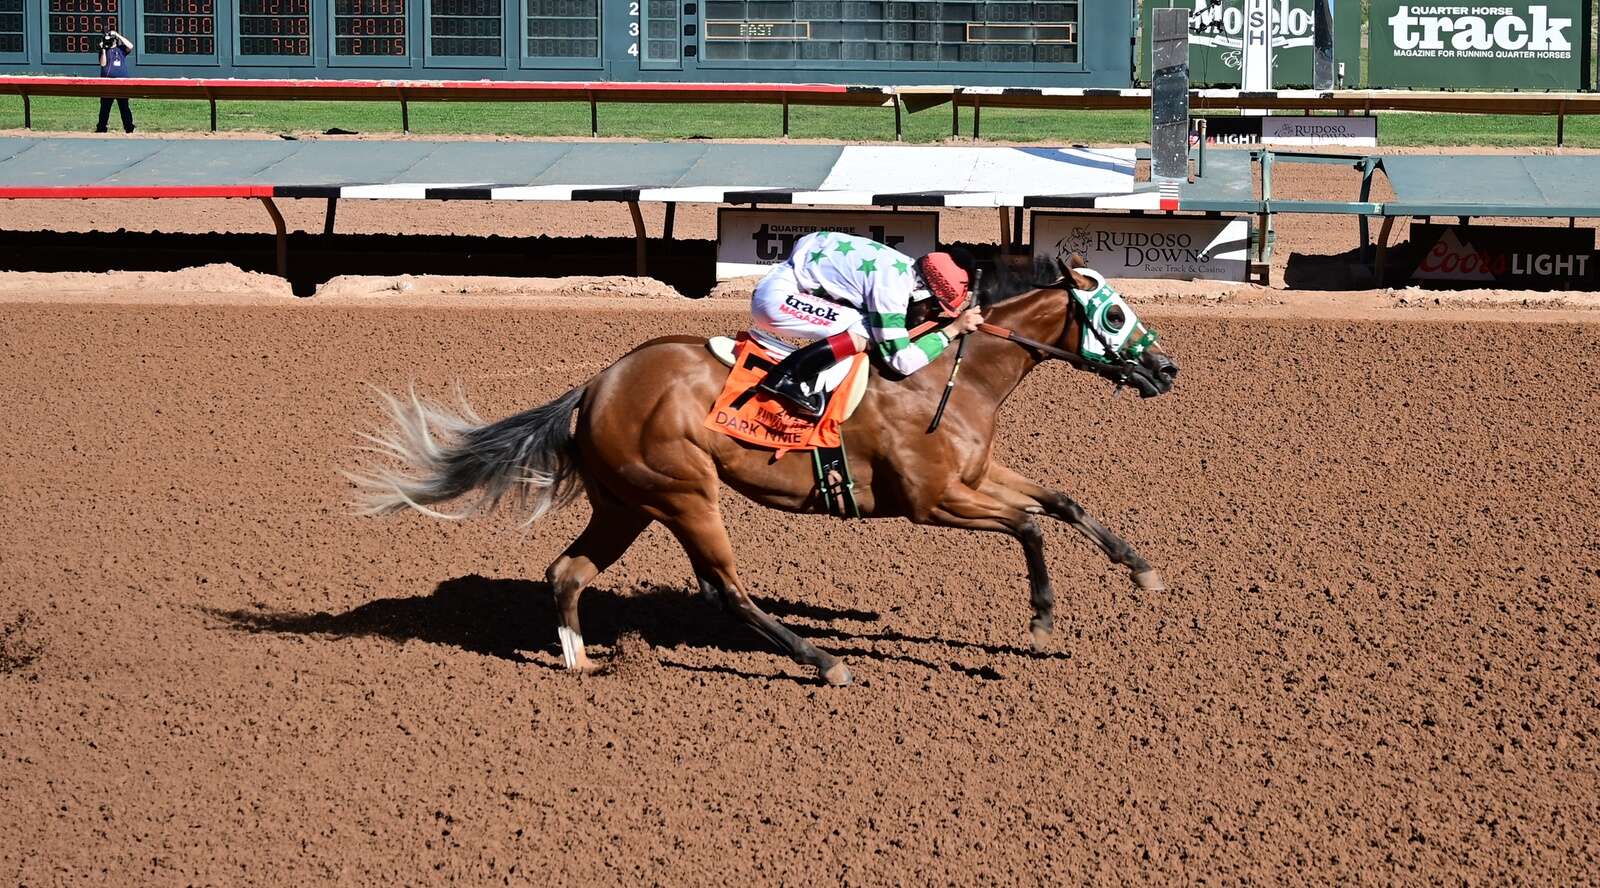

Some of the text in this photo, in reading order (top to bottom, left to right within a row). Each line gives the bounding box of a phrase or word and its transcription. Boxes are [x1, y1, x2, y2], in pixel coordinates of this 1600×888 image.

[629, 2, 639, 16] 2
[1410, 6, 1514, 16] QUARTER HORSE
[167, 17, 212, 34] 1080
[271, 18, 308, 35] 710
[352, 19, 404, 35] 2010
[628, 22, 640, 36] 3
[740, 24, 774, 36] FAST
[1388, 5, 1572, 51] track
[271, 38, 308, 55] 740
[352, 38, 404, 55] 2115
[627, 43, 639, 57] 4
[1438, 50, 1455, 58] FOR
[1456, 50, 1494, 58] RUNNING
[1495, 51, 1535, 59] QUARTER
[1537, 51, 1572, 59] HORSES
[1216, 134, 1258, 144] LIGHT
[1295, 125, 1346, 137] RUIDOSO
[770, 225, 818, 233] QUARTER
[1095, 230, 1192, 252] RUIDOSO
[1124, 246, 1210, 268] DOWNS
[1511, 253, 1591, 277] LIGHT
[1144, 264, 1226, 274] Race Track & Casino
[785, 294, 840, 322] track
[729, 352, 779, 410] 7
[715, 410, 760, 438] DARK
